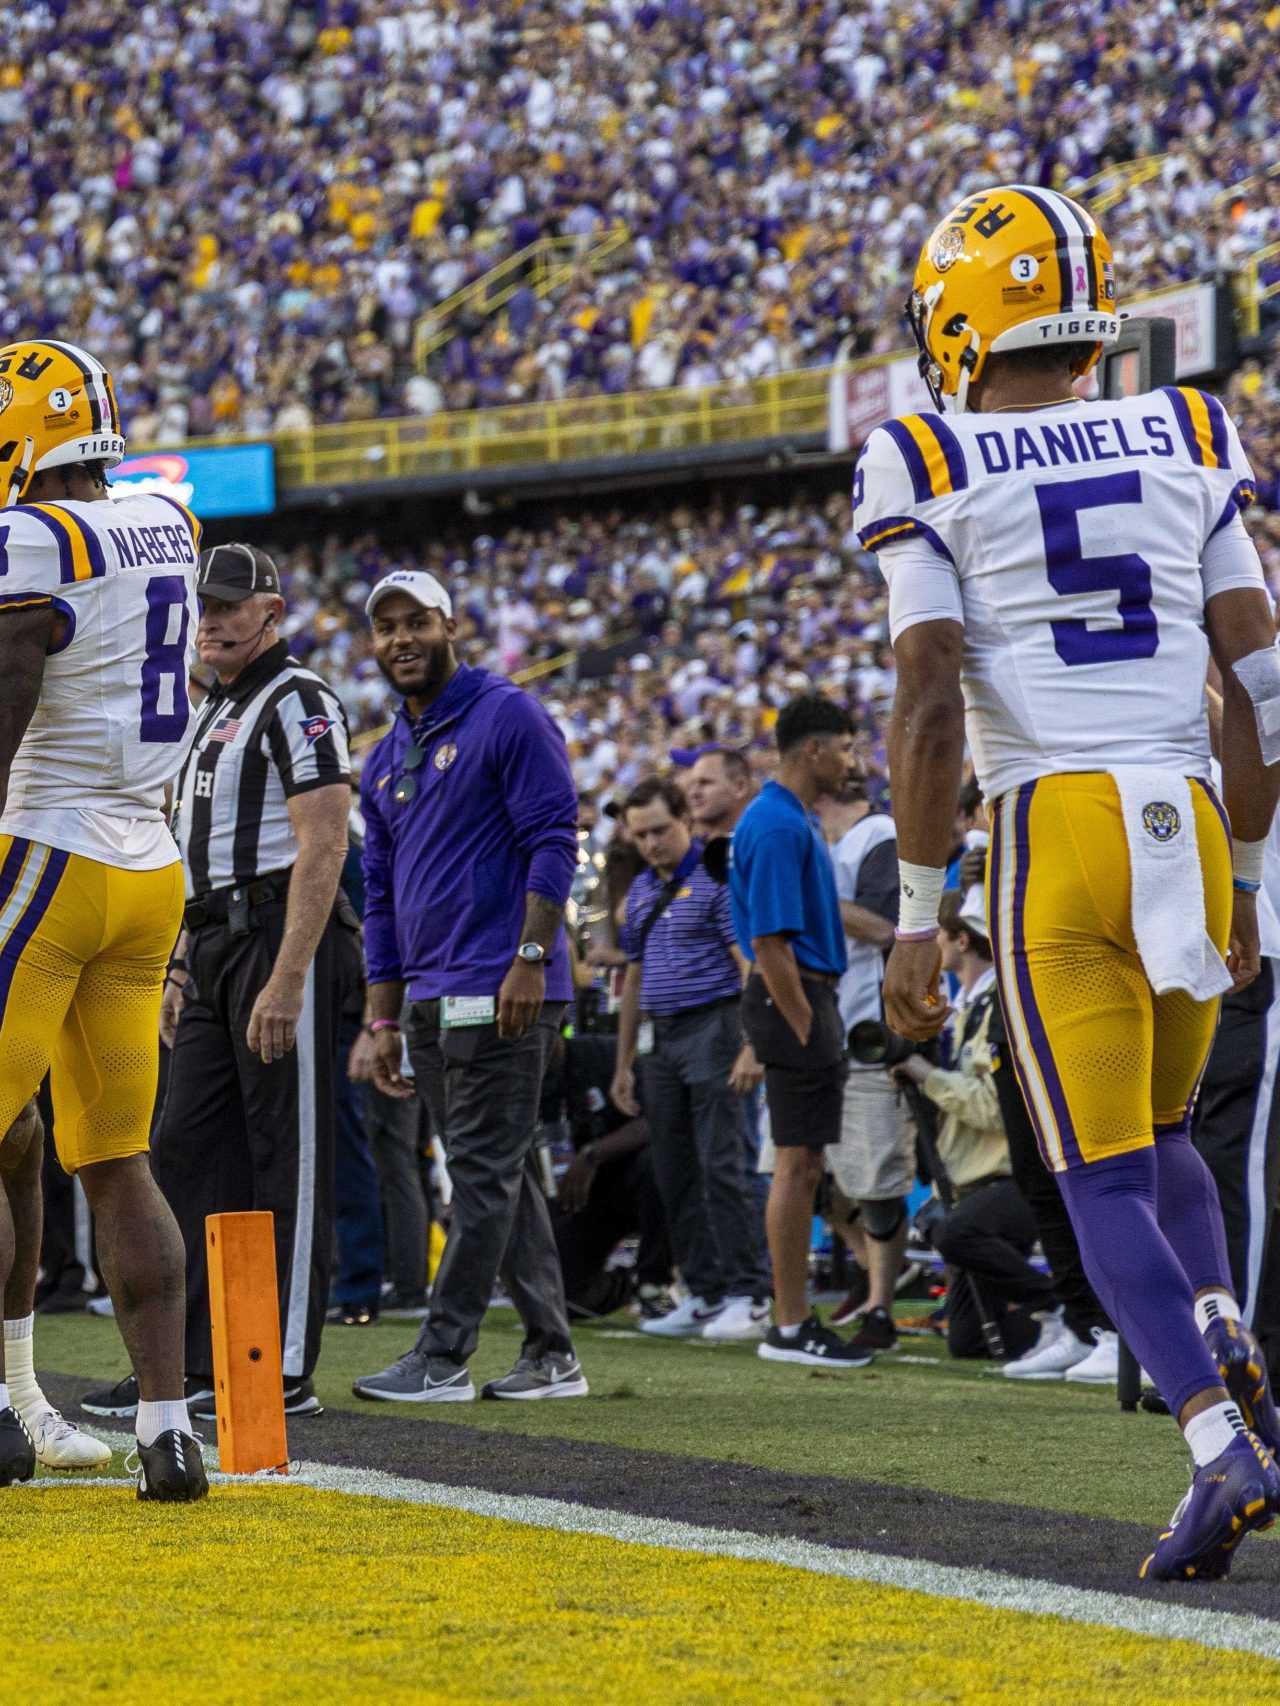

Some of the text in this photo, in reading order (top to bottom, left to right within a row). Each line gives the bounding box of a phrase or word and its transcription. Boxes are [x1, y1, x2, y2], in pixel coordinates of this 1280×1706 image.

[1019, 259, 1030, 278] 3
[1039, 320, 1117, 338] TIGERS
[55, 391, 66, 408] 3
[78, 440, 124, 454] TIGER
[975, 415, 1175, 475] DANIELS
[107, 524, 195, 569] NABERS
[1034, 470, 1160, 666] 5
[140, 575, 189, 743] 8
[195, 771, 214, 798] H
